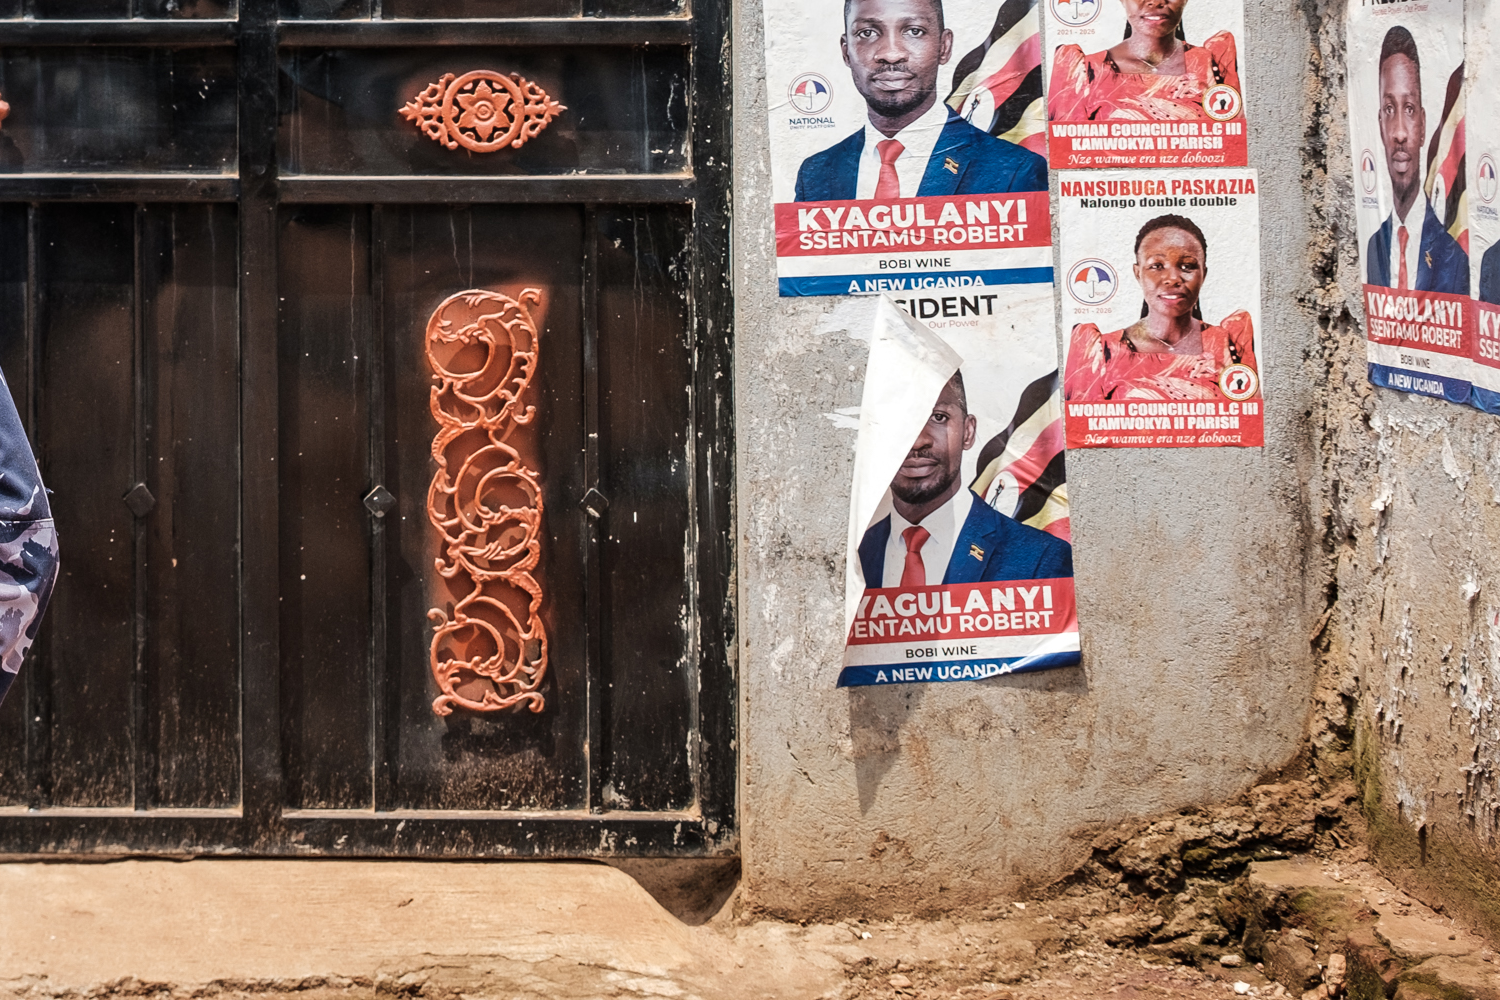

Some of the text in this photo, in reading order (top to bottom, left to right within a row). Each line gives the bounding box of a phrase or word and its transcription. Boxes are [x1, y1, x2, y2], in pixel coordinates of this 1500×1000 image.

[789, 117, 835, 125] NATIONAL
[1052, 122, 1242, 137] WOMAN COUNCILLOR L.C III
[1071, 136, 1223, 151] KAMWOKYA II PARISH
[1067, 151, 1225, 166] Nze wamwe era nze doboozi
[1061, 179, 1256, 197] NANSUBUGA PASKAZIA
[1080, 196, 1237, 209] Nalongo double double
[798, 199, 1027, 232] KYAGULANYI
[799, 223, 1028, 251] SSENTAMU ROBERT
[879, 257, 951, 270] BOBI WINE
[848, 275, 986, 293] A NEW UGANDA
[1367, 291, 1463, 328] KYAGULANYI
[929, 320, 979, 329] Our Power
[1370, 318, 1463, 349] SSENTAMU ROBERT
[1400, 353, 1430, 369] BOBI WINE
[1388, 372, 1445, 396] A NEW UGANDA
[1068, 402, 1258, 417] WOMAN COUNCILLOR L.C III
[1088, 416, 1239, 430] KAMWOKYA II PARISH
[1084, 432, 1242, 445] Nze wamwe era nze doboozi
[850, 610, 1054, 638] ENTAMU ROBERT
[905, 645, 977, 659] BOBI WINE
[875, 662, 1012, 683] A NEW UGANDA
